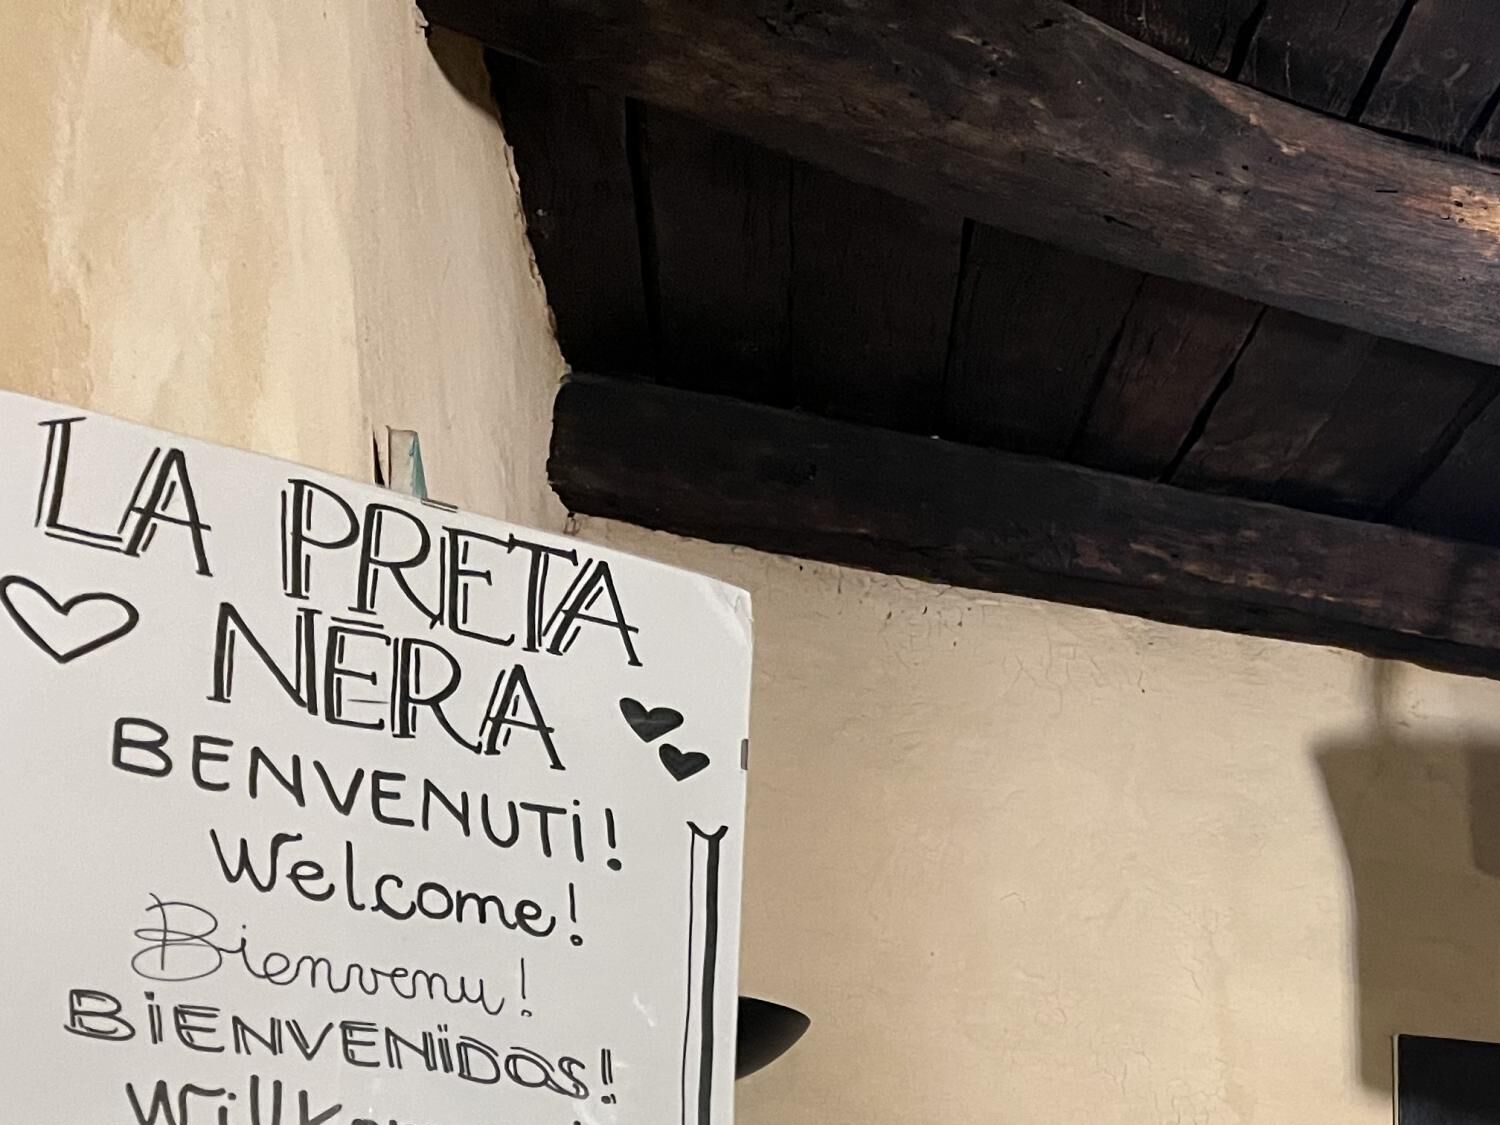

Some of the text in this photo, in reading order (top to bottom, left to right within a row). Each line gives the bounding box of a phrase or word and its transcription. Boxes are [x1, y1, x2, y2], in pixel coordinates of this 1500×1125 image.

[36, 417, 643, 666] LA PRETA
[206, 602, 566, 771] NERA
[130, 891, 533, 1018] Bienvenu!
[209, 828, 586, 947] Welcome!
